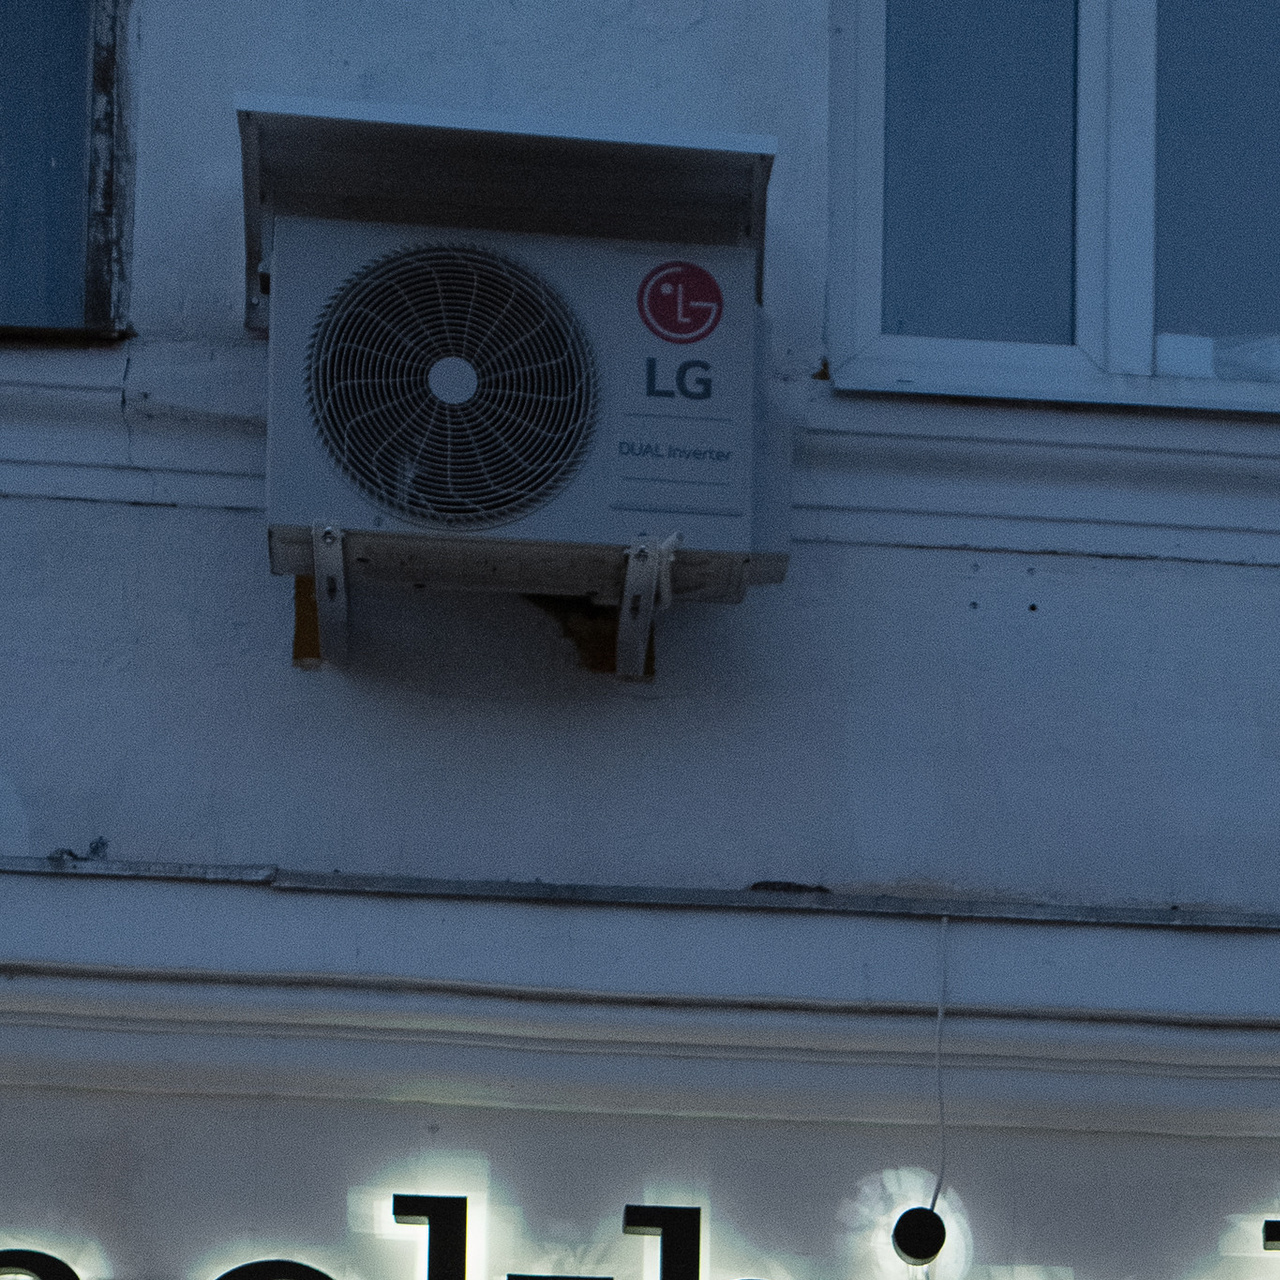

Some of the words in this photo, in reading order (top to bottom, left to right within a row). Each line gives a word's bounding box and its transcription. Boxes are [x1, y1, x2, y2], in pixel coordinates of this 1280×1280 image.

[645, 356, 713, 401] LG
[617, 440, 664, 459] DUAL
[667, 443, 732, 464] Inverter
